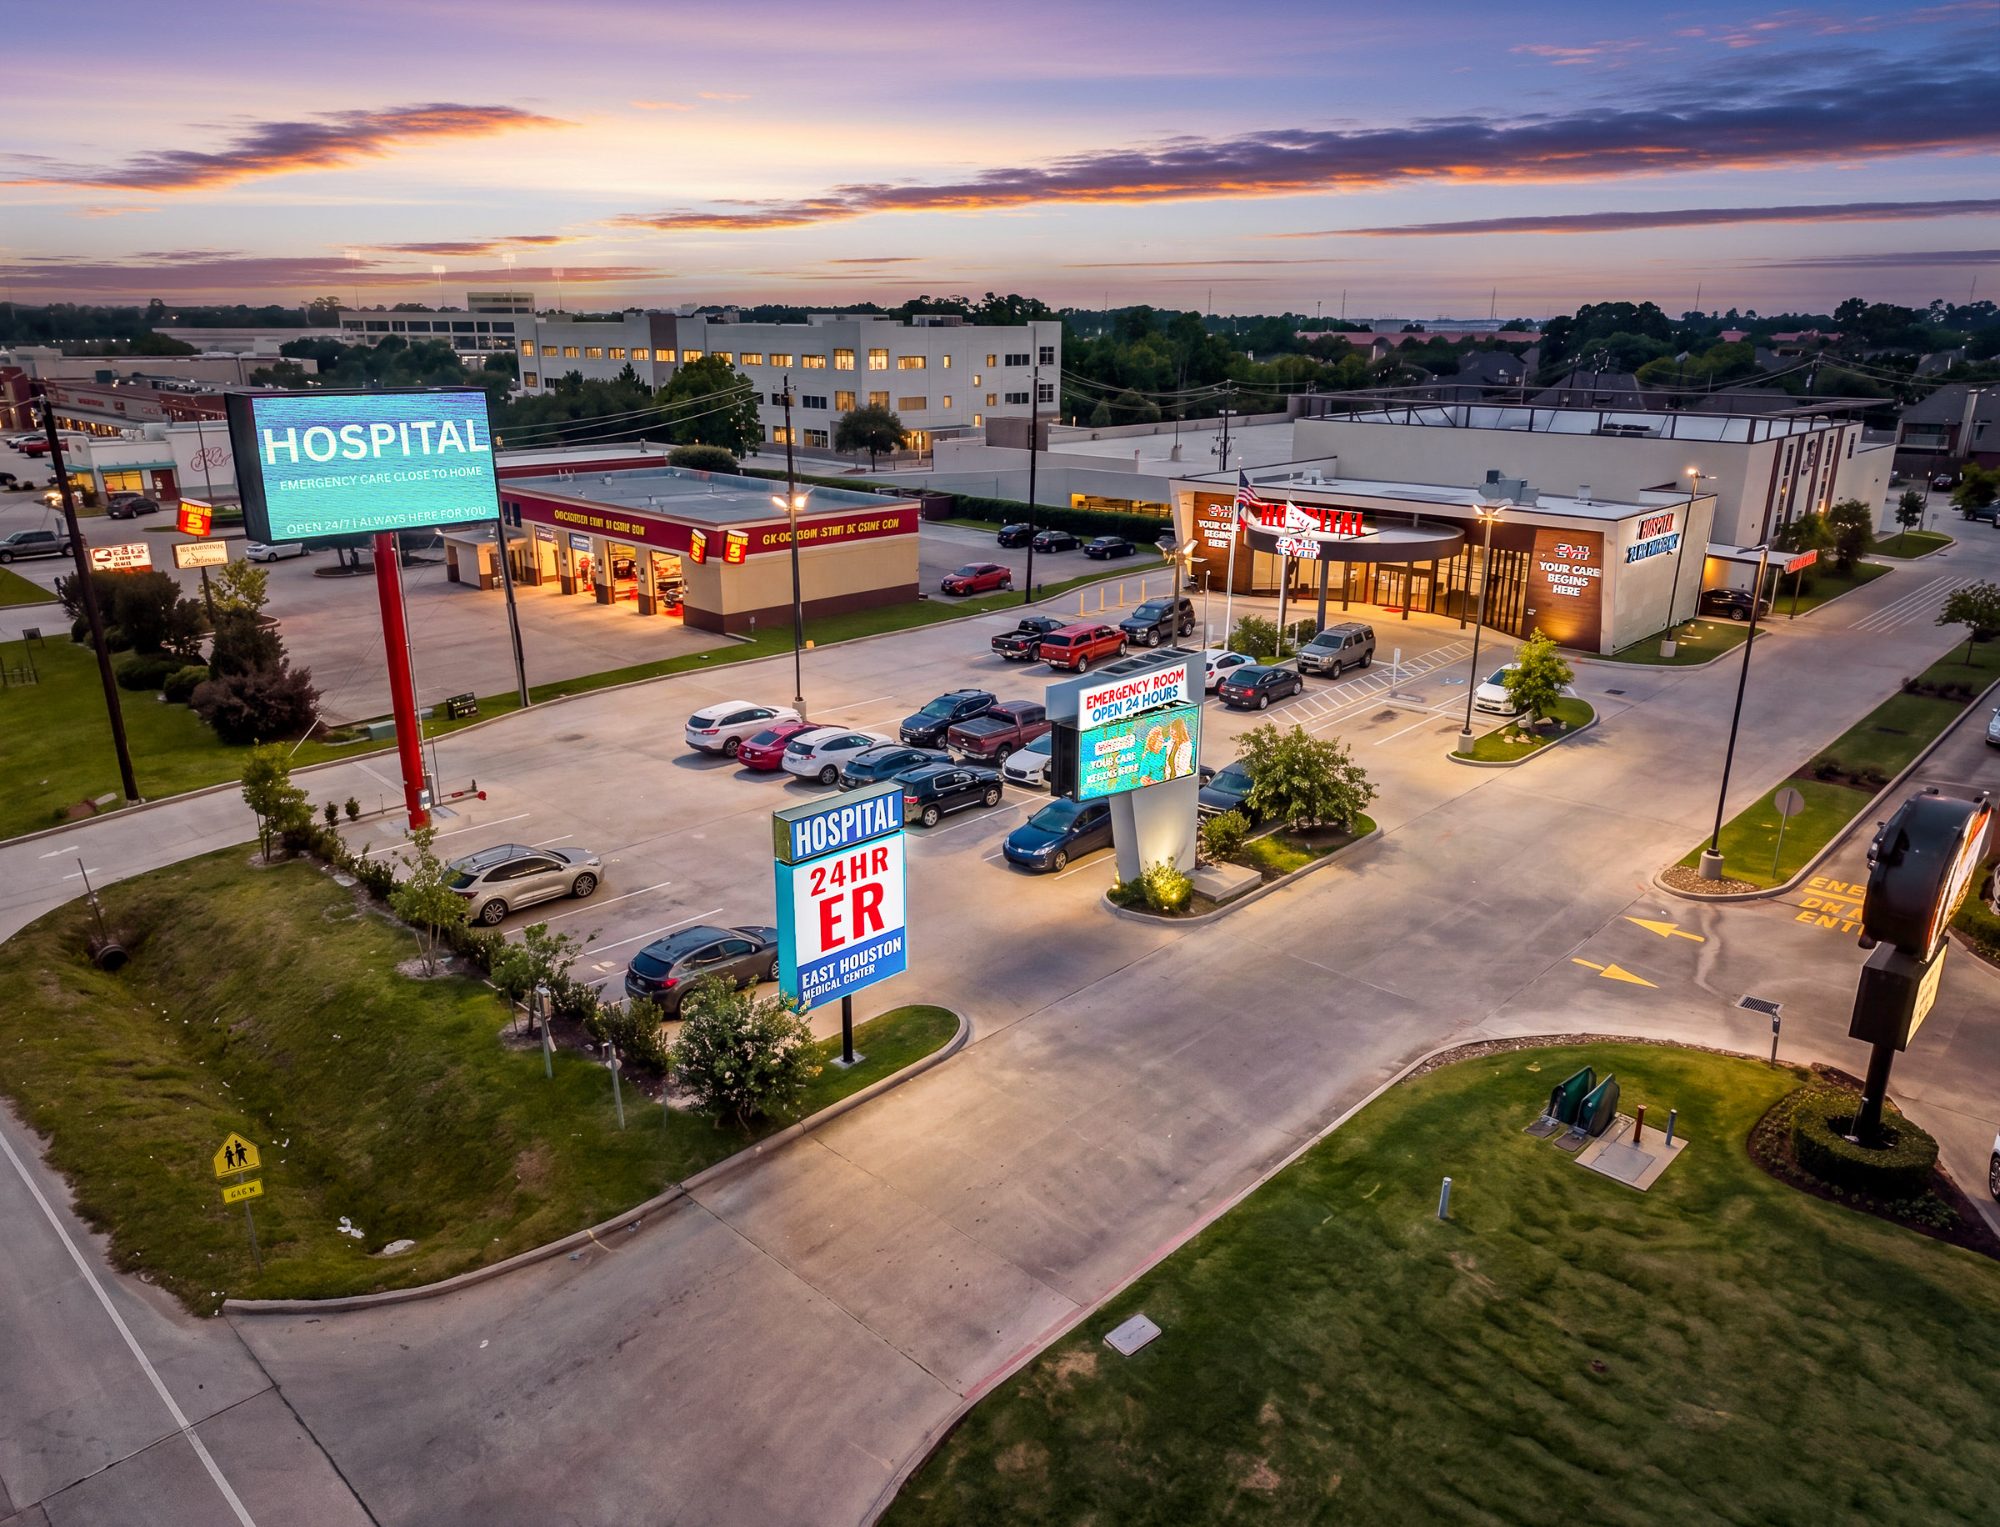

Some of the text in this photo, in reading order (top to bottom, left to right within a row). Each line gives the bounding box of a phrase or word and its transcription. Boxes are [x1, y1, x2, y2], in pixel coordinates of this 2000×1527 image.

[263, 419, 490, 464] HOSPITAL
[280, 466, 483, 491] EMERGENCY CARE CLOSE TO HOME
[188, 514, 203, 528] 5
[287, 522, 322, 534] OPEN
[325, 519, 350, 532] 24/7
[360, 514, 406, 528] ALWAYS
[408, 510, 439, 522] HERE
[440, 508, 462, 520] FOR
[463, 506, 487, 517] YOU
[1198, 520, 1241, 532] YOUR CAE
[1261, 504, 1366, 536] HOPITAL
[1640, 512, 1674, 540] HOSPITAL
[730, 544, 740, 557] 5
[1540, 561, 1601, 577] YOUR CARE
[1548, 573, 1588, 586] BEGINS
[1552, 584, 1580, 596] HERE
[1086, 668, 1185, 710] EMERGENCY ROOM
[1092, 685, 1178, 722] OPEN 24 HOURS
[796, 796, 898, 857] HOSPITAL
[810, 846, 889, 897] 24HR
[819, 882, 885, 952] ER
[802, 936, 902, 989] EAST HOUSTON
[802, 965, 876, 1002] MEDICAL CENTER
